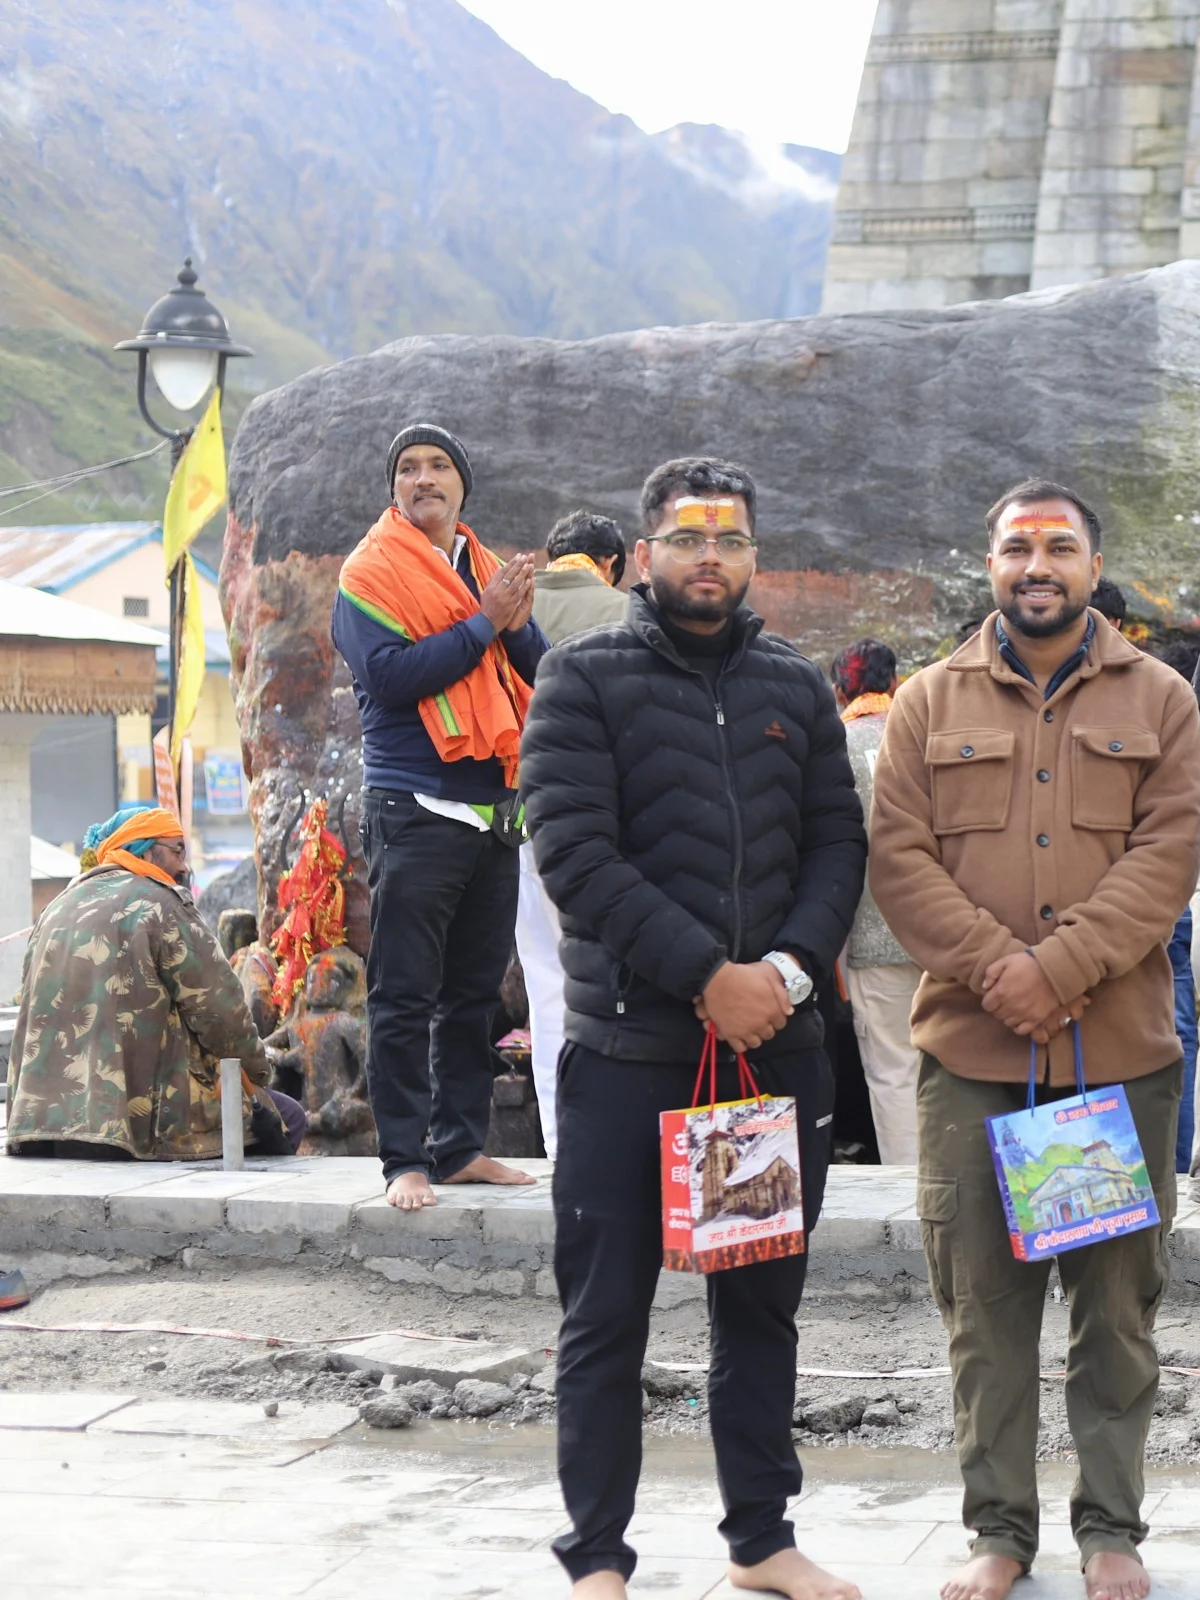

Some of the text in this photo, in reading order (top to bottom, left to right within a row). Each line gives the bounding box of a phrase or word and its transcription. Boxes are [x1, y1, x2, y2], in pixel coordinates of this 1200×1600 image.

[1034, 1233, 1049, 1250] श्री
[1090, 1218, 1104, 1234] जी
[1104, 1217, 1123, 1235] पूजा
[1123, 1208, 1148, 1227] प्रसाद
